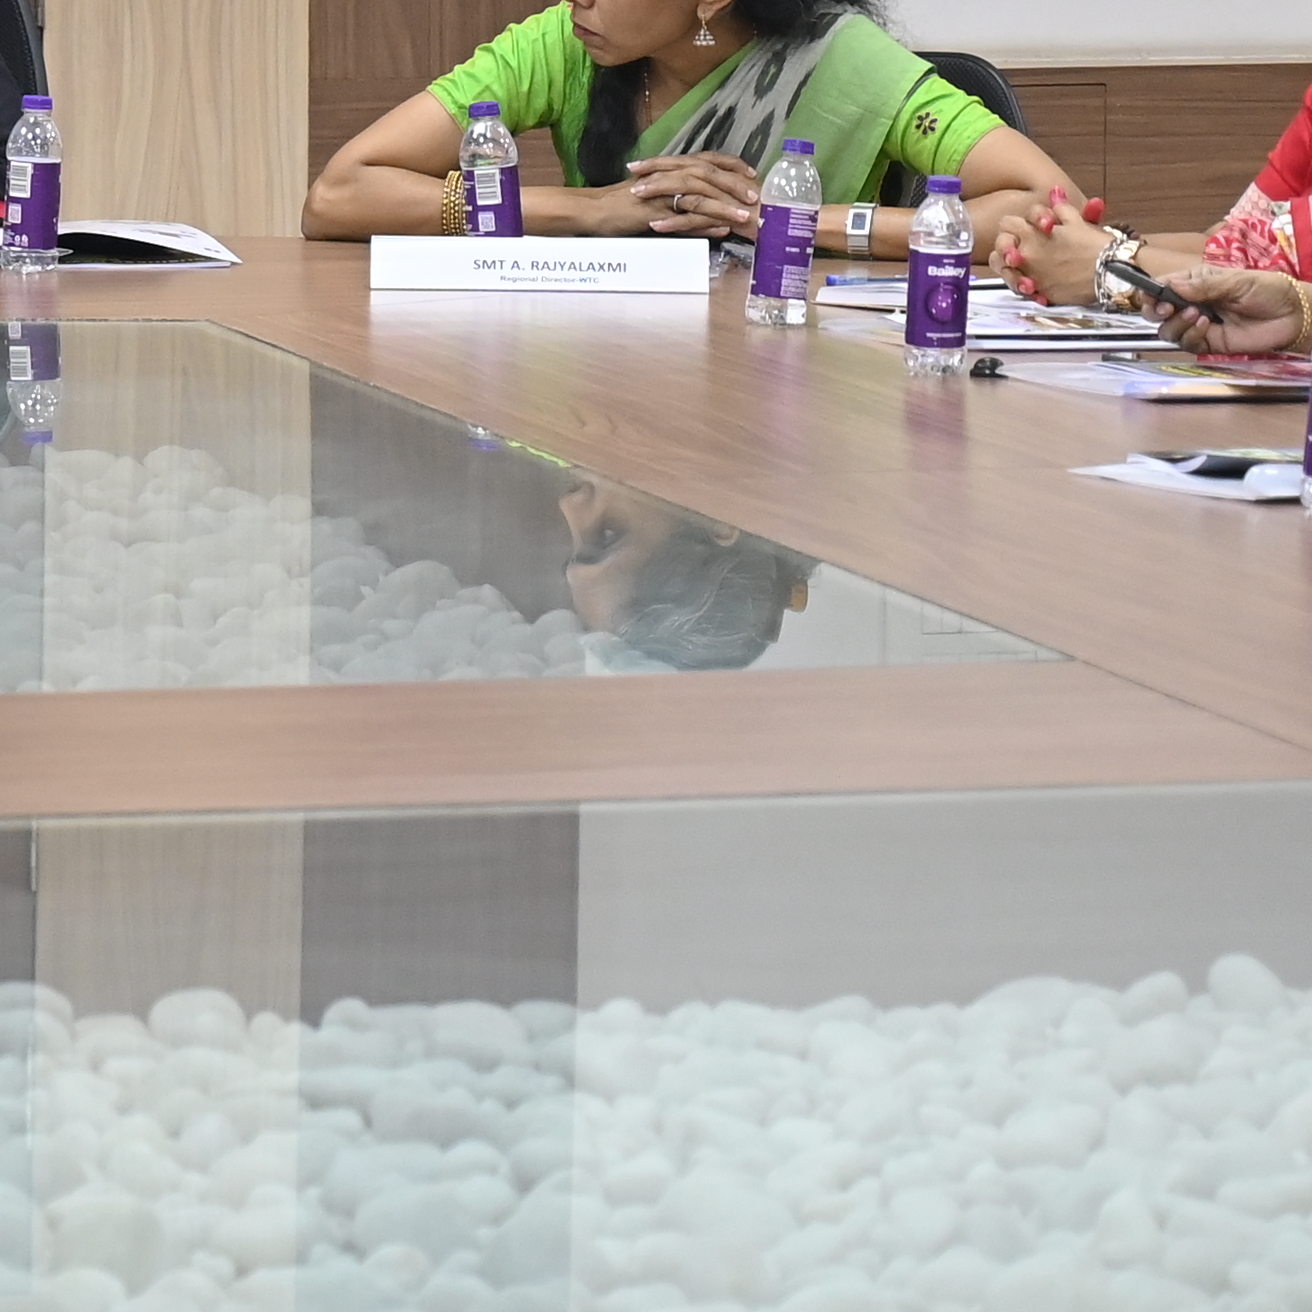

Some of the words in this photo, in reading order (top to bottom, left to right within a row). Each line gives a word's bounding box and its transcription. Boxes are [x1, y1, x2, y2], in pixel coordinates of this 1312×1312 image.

[473, 259, 506, 270] SMT
[510, 260, 525, 271] A.
[530, 261, 627, 273] RAJYALAXMI
[927, 265, 966, 279] Bailey
[500, 275, 538, 283] Regional
